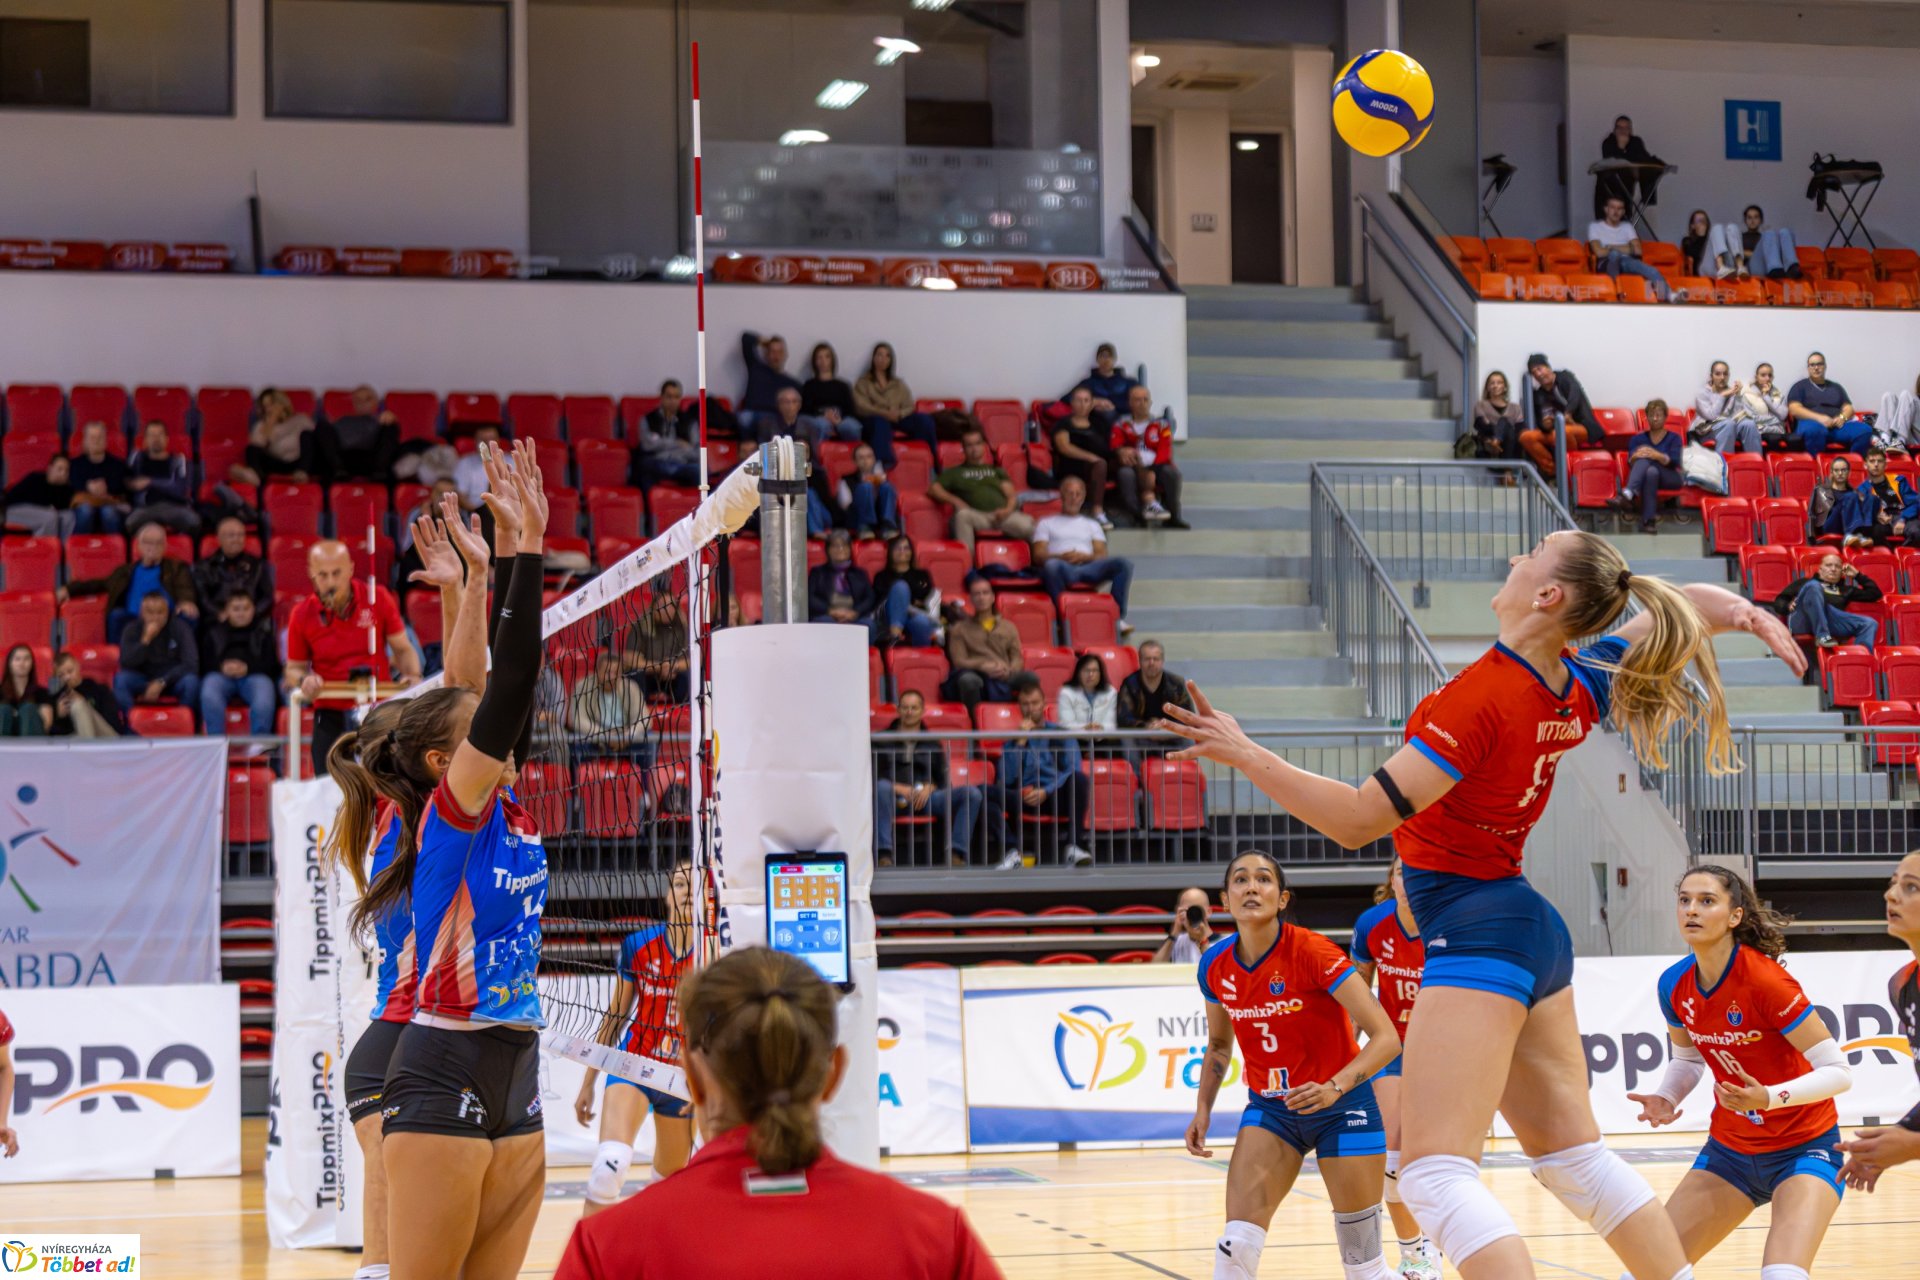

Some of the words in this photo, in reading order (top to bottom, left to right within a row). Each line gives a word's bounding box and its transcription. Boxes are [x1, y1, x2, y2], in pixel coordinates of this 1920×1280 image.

[307, 824, 334, 981] TippmixPRO
[1396, 979, 1419, 1001] 18
[1252, 1022, 1279, 1053] 3
[312, 1051, 337, 1209] TippmixPRO
[1347, 1118, 1368, 1127] nine
